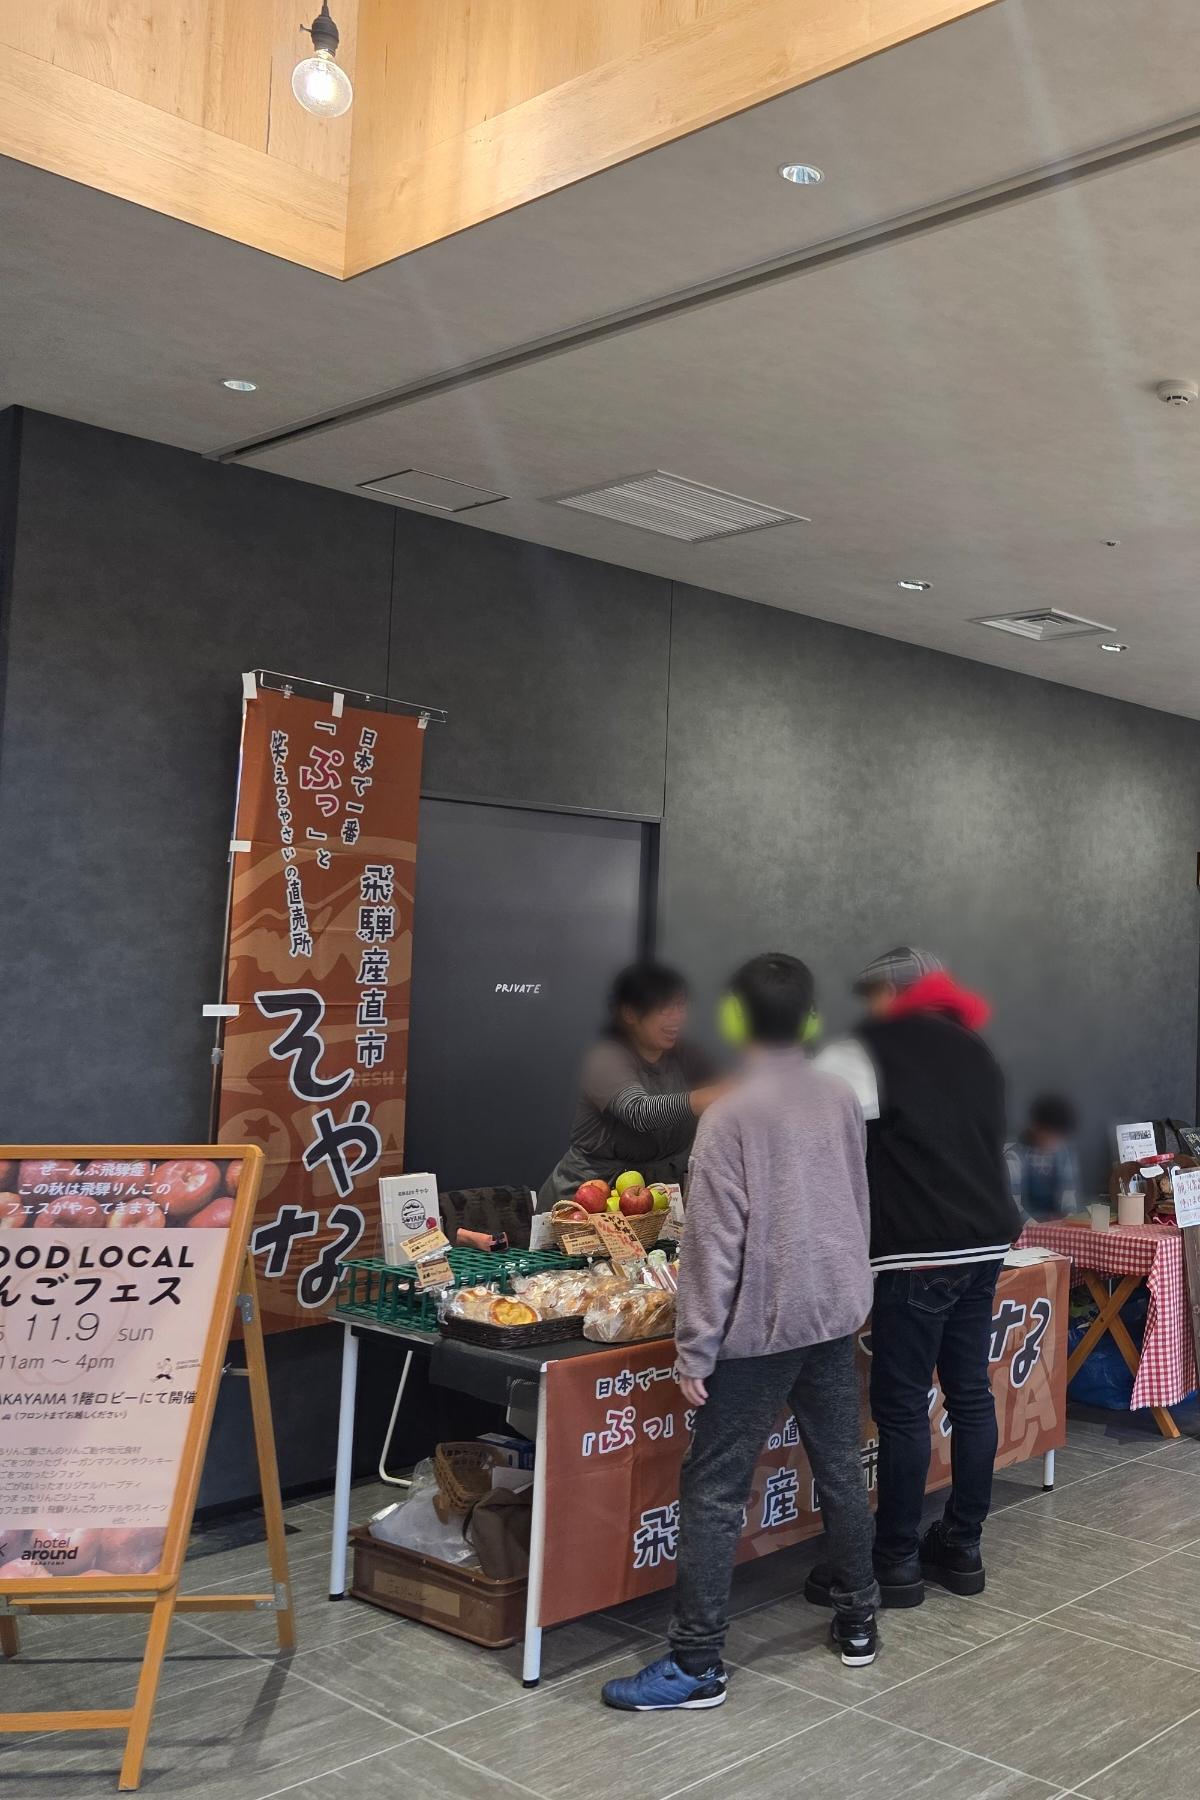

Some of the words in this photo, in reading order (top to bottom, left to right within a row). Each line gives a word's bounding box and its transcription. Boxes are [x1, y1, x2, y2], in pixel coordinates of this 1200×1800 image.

[341, 727, 377, 845] 日本で一番
[271, 730, 313, 957] 笑えるやさいの直売所
[356, 864, 396, 1068] 飛騨産直市
[495, 984, 541, 993] PRIVATE
[252, 988, 382, 1308] そやな
[18, 1183, 171, 1196] この秋は飛騨りんごの
[6, 1202, 170, 1215] フェスがやってきます！
[79, 1246, 194, 1268] LOCAL
[26, 1312, 100, 1341] 11.9
[117, 1327, 154, 1342] sun
[76, 1354, 115, 1372] 4pm
[72, 1391, 197, 1405] 1階ロビーにて開催
[33, 1537, 71, 1549] hotel
[21, 1547, 79, 1561] around
